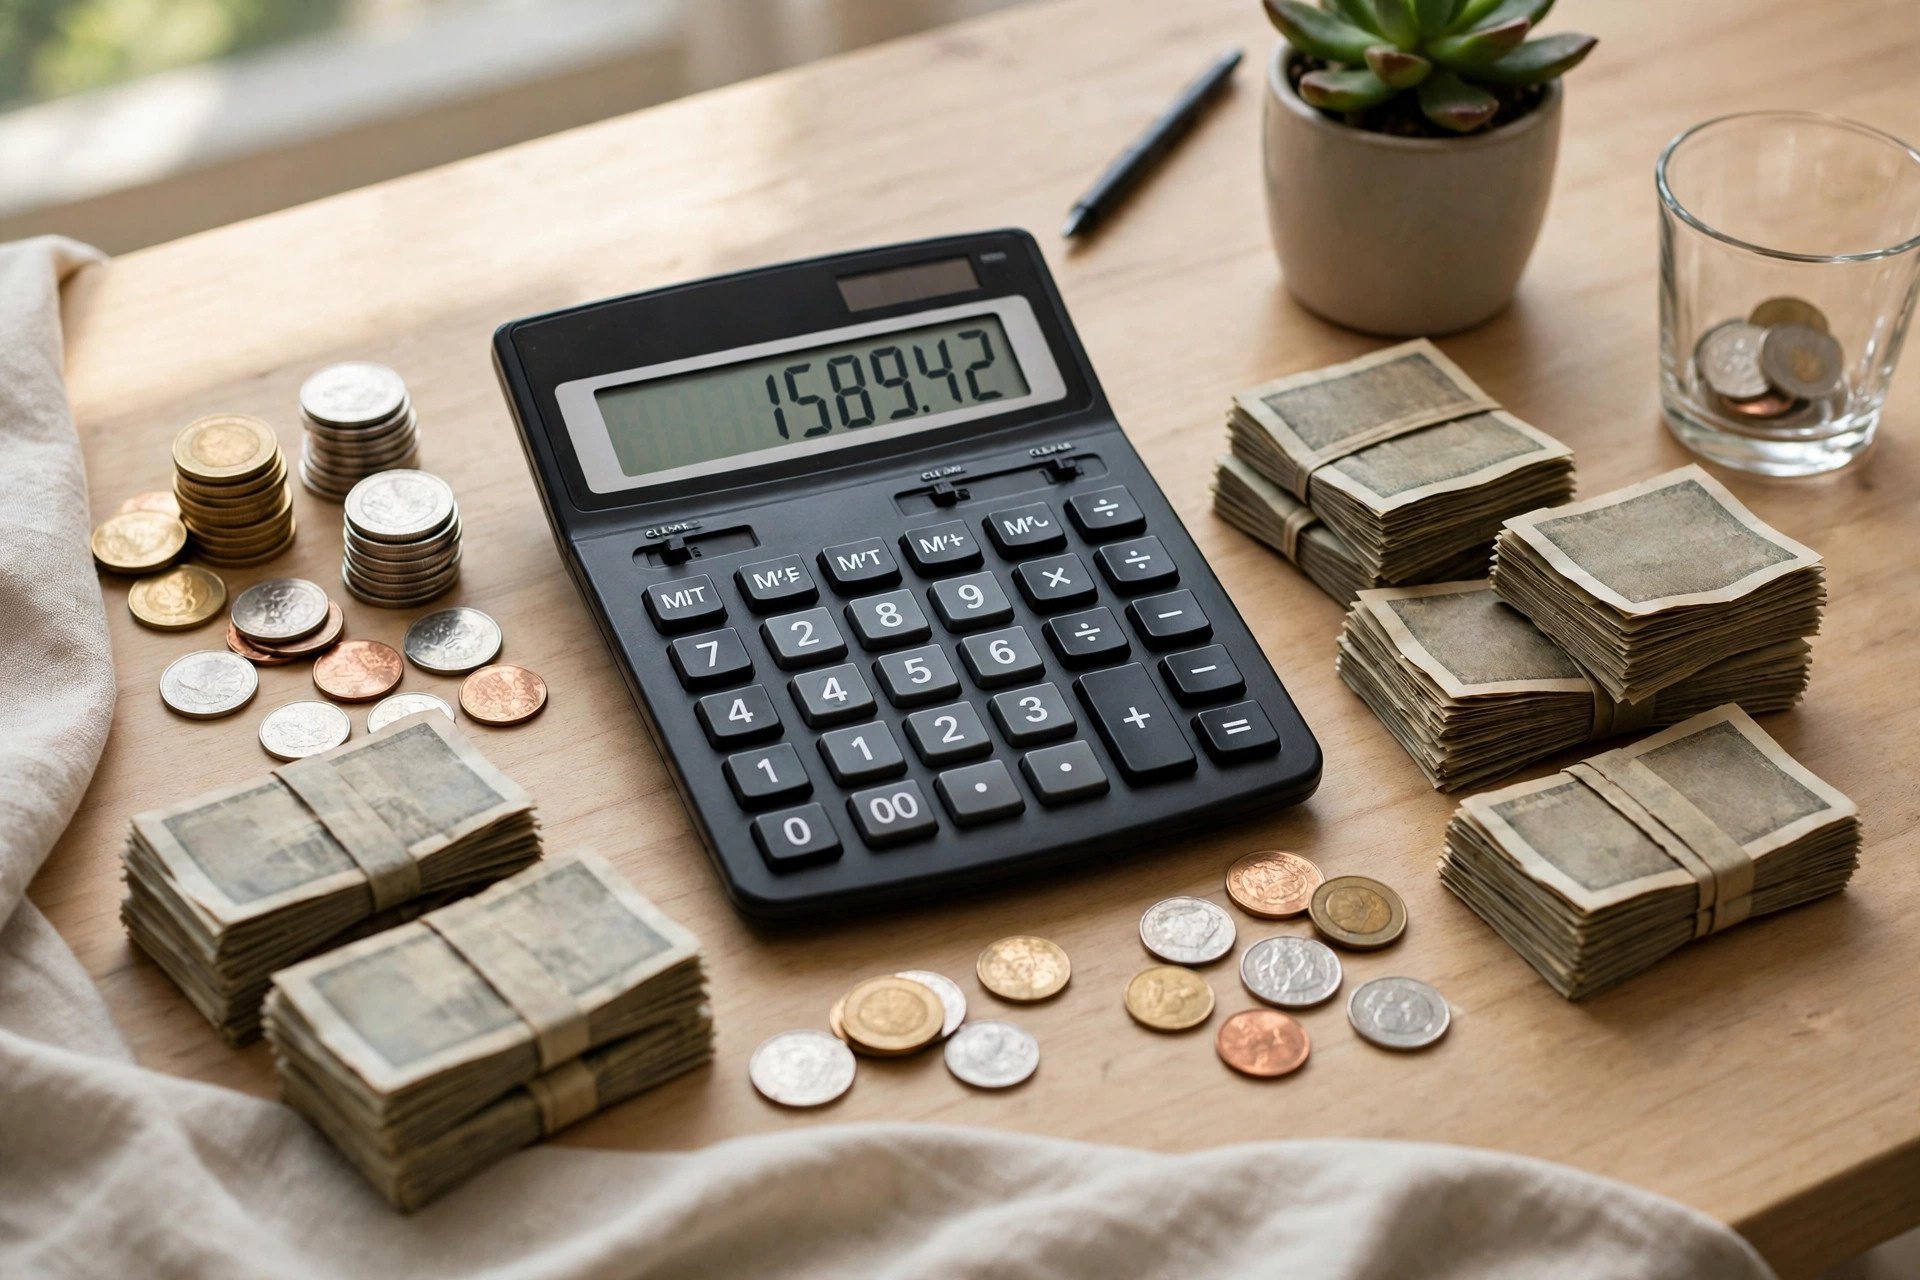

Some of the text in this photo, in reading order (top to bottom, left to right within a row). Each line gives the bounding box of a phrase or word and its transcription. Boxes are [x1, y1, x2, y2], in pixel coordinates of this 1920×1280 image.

[765, 329, 1003, 440] 1589.42
[957, 584, 985, 609] 9
[874, 602, 903, 628] 8
[790, 620, 820, 647] 2
[696, 641, 718, 668] 7
[989, 639, 1016, 665] 6
[903, 656, 932, 684] 5
[822, 677, 848, 702] 4
[728, 698, 754, 723] 4
[1019, 696, 1048, 723] 3
[934, 715, 965, 744] 2
[851, 736, 873, 761] 1
[757, 758, 779, 783] 1
[869, 791, 919, 824] 00
[783, 817, 812, 846] 0
